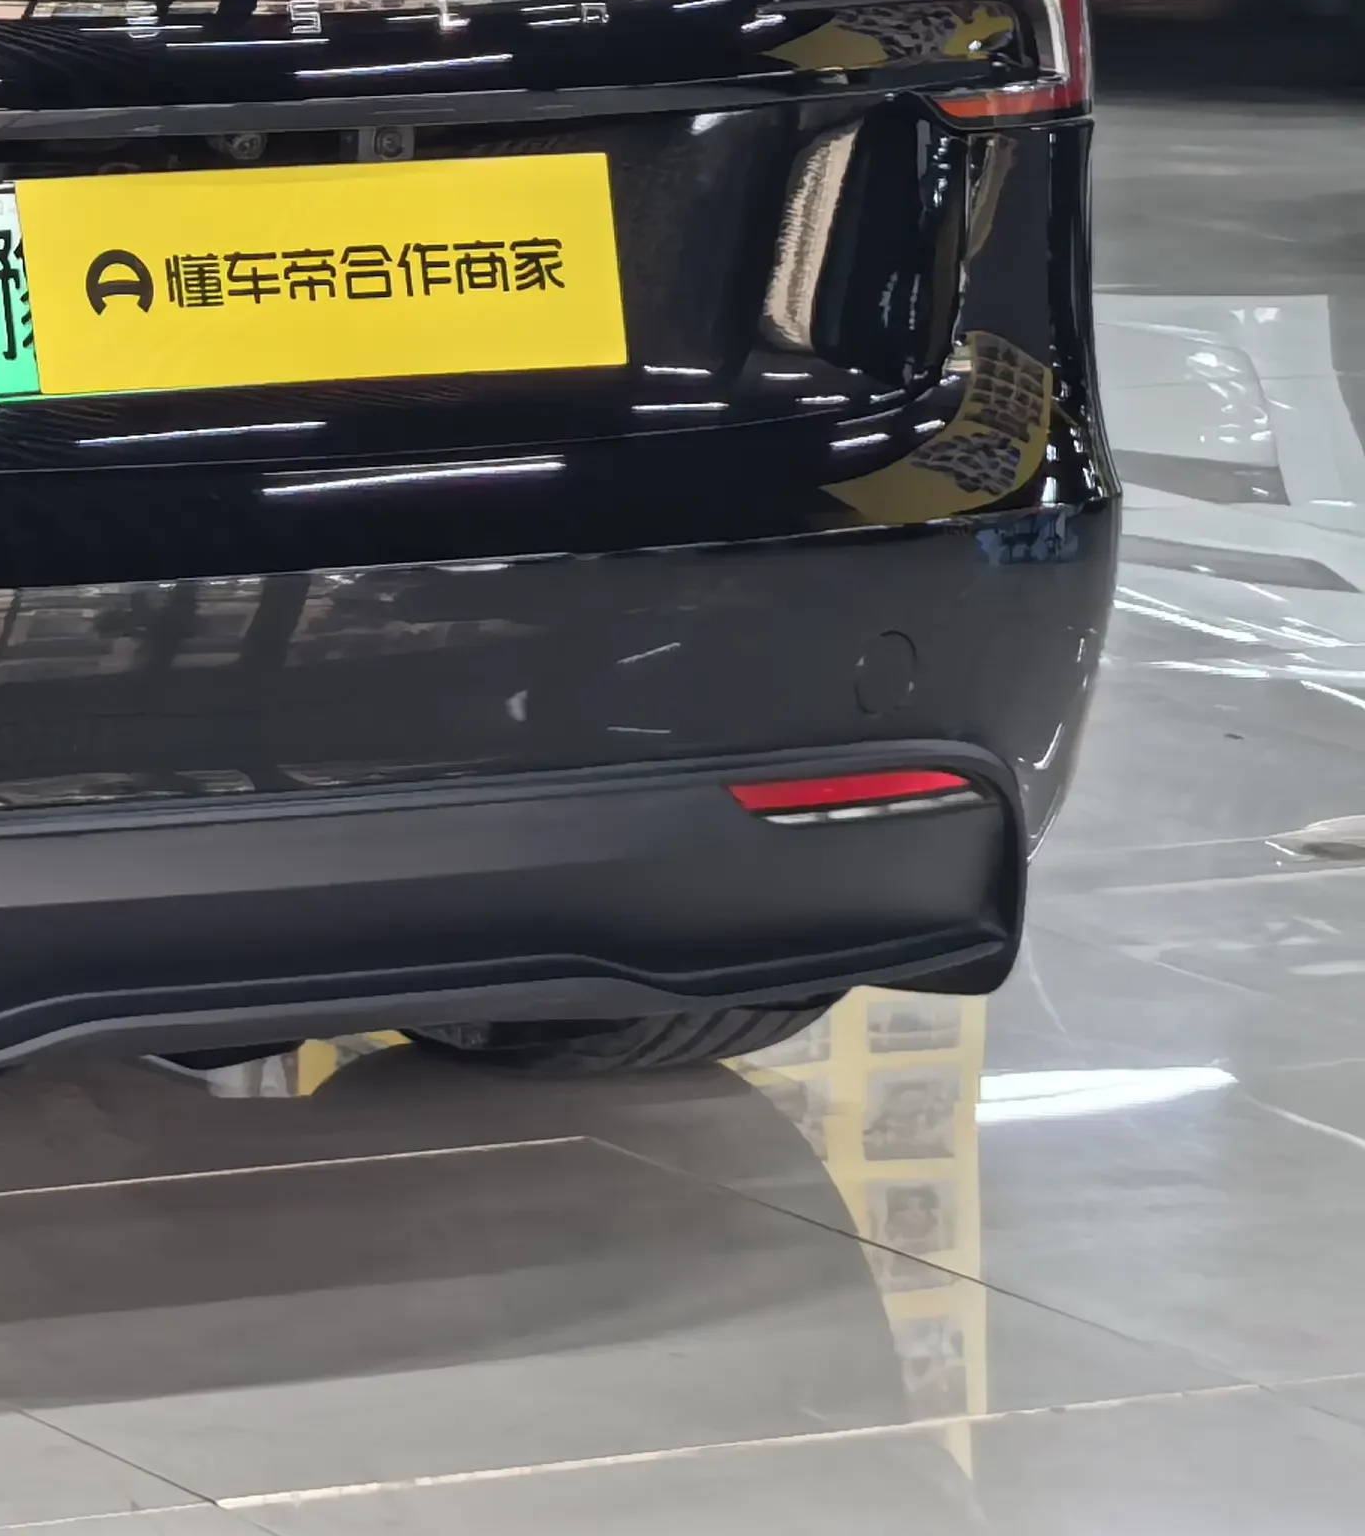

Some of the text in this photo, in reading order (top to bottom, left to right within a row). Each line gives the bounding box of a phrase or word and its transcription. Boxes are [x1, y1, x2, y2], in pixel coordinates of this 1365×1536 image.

[165, 237, 566, 309] 懂车帝合作商家
